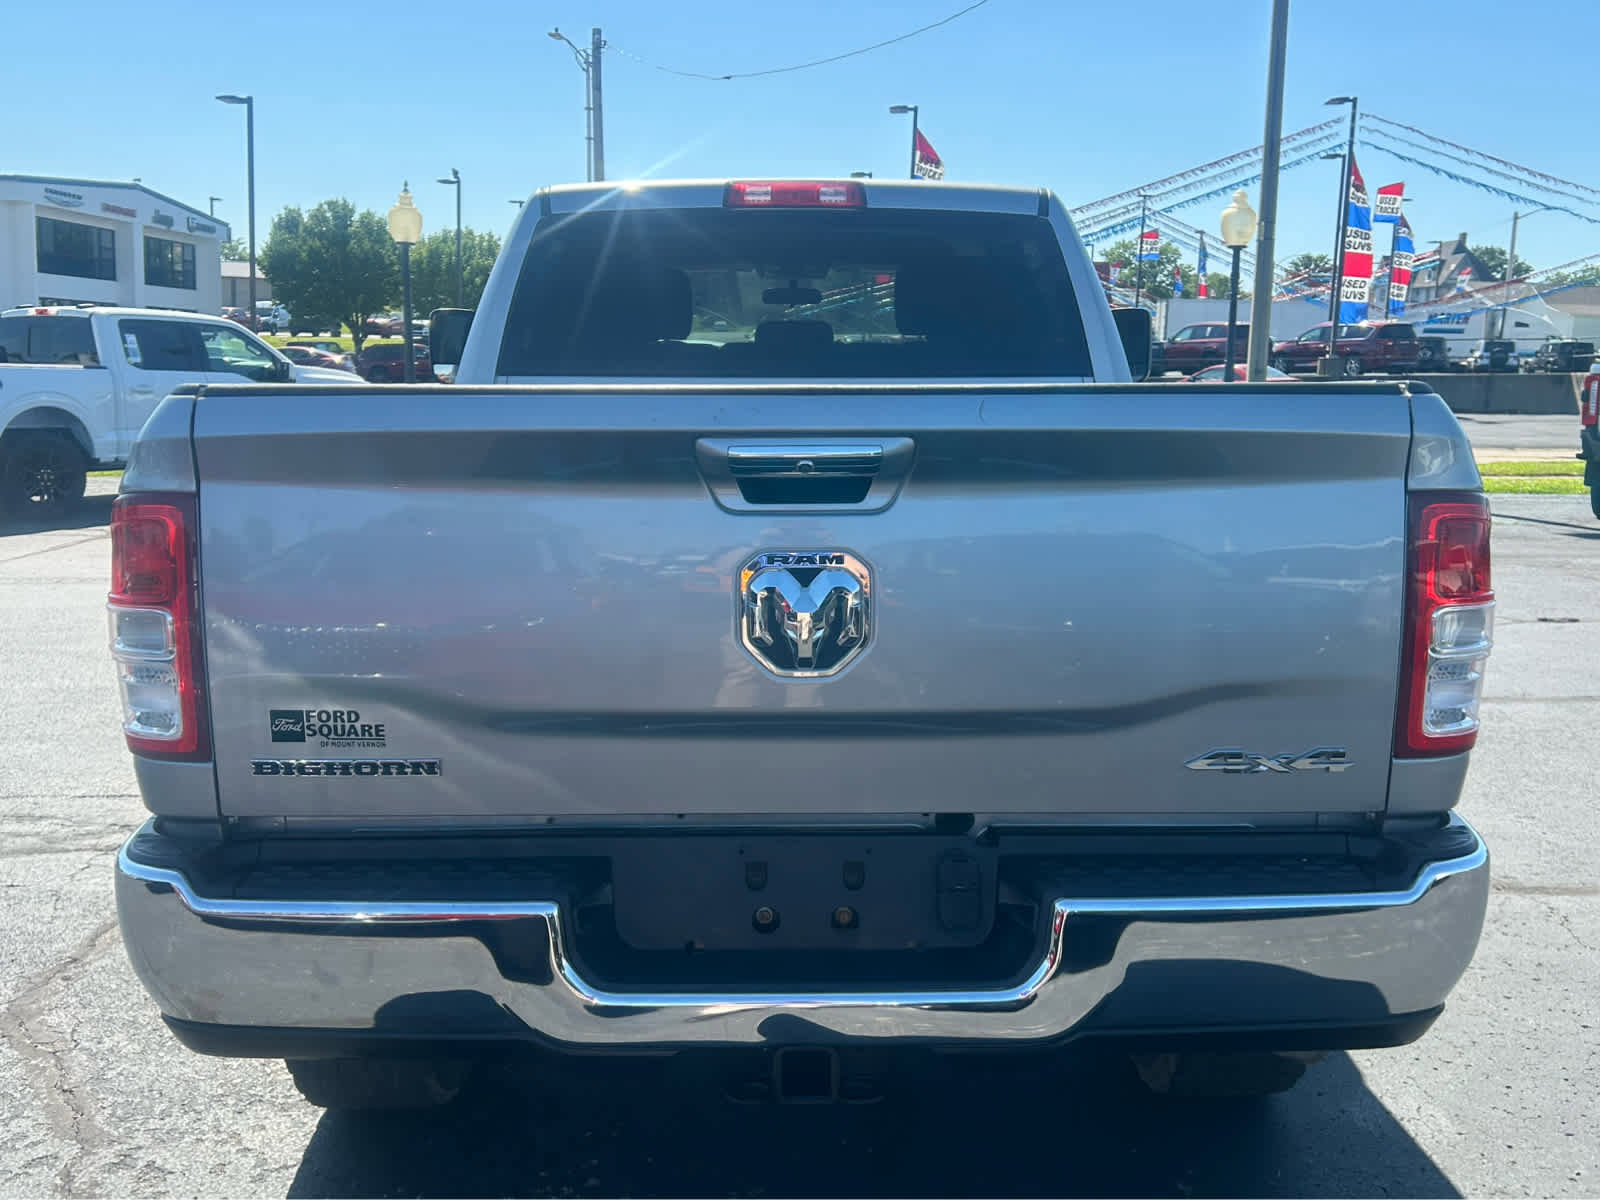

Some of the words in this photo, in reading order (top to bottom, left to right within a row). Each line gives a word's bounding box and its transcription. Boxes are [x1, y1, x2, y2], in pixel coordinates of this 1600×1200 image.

[1379, 195, 1398, 205] USED
[1345, 240, 1372, 251] SUVS
[767, 555, 845, 565] RAM
[305, 710, 360, 723] FORD
[272, 719, 303, 732] Ford
[306, 724, 385, 738] SQUARE
[250, 758, 441, 776] BIGHORN
